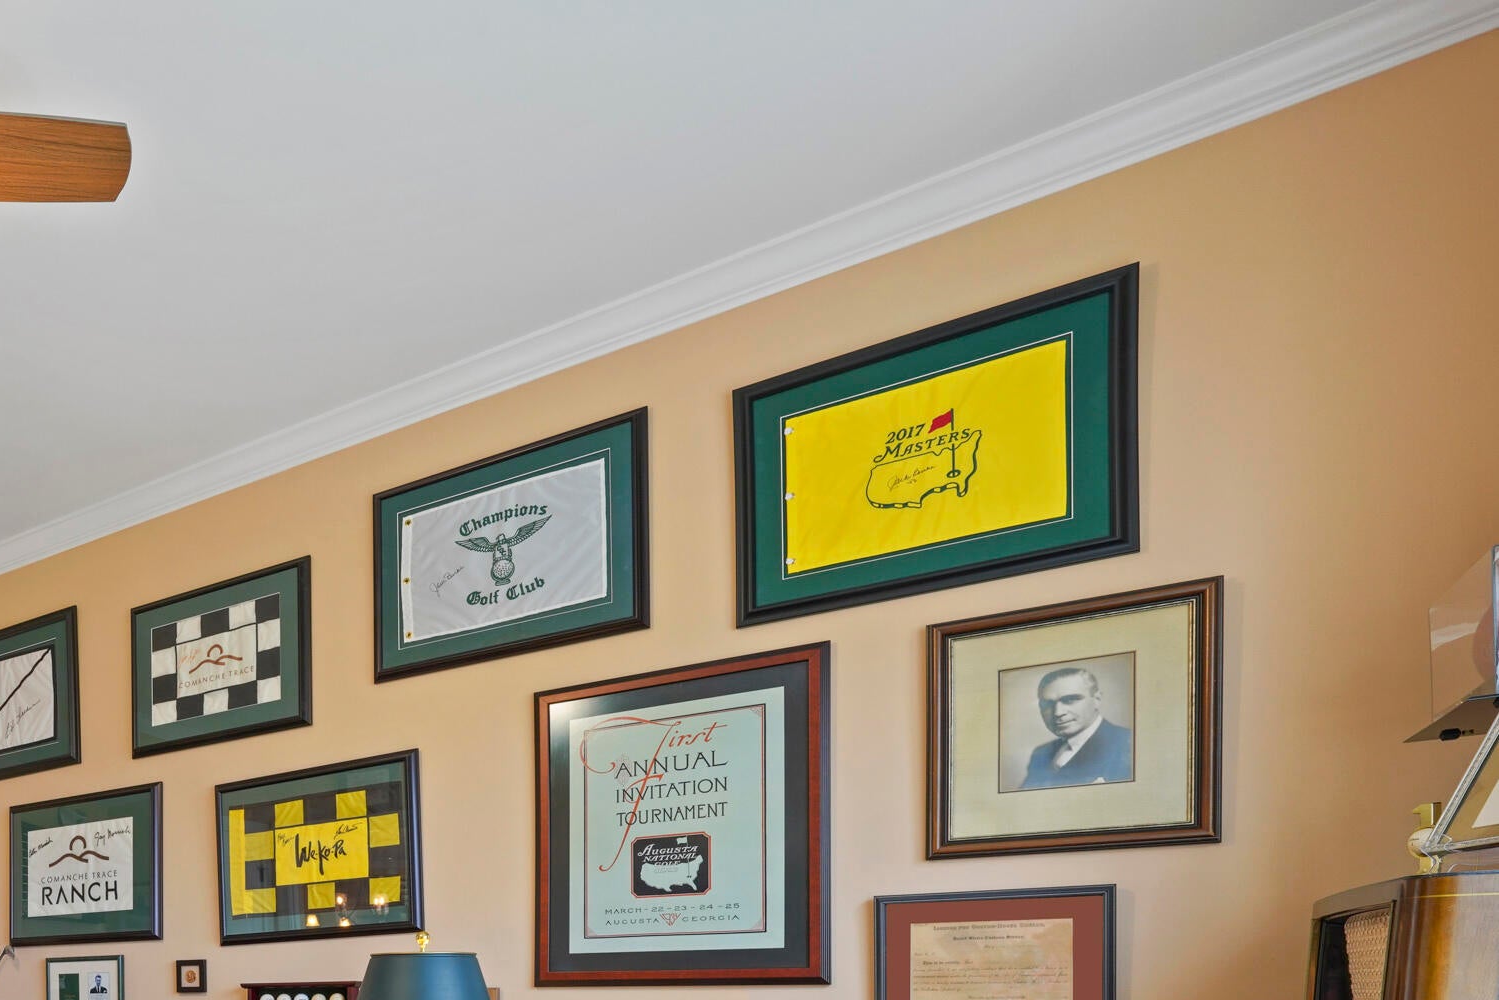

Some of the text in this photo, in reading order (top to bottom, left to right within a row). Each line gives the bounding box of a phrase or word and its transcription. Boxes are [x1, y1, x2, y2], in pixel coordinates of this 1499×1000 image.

[873, 428, 970, 463] MASTERS
[885, 423, 925, 444] 2017
[459, 503, 548, 537] Champions
[466, 577, 545, 606] Golf Club
[178, 665, 254, 689] COMANCHE TRACE
[614, 750, 728, 780] ANNUAL
[615, 777, 728, 804] INVITATION
[616, 801, 728, 827] TOURNAMENT
[637, 843, 700, 857] AUGUSTA
[643, 852, 698, 862] NATIONAL
[41, 869, 118, 884] COMANCHE TRACE
[41, 880, 118, 906] RANCH
[604, 907, 643, 916] MARCH
[605, 917, 660, 926] AUGUSTA
[681, 914, 741, 923] GEORGIA
